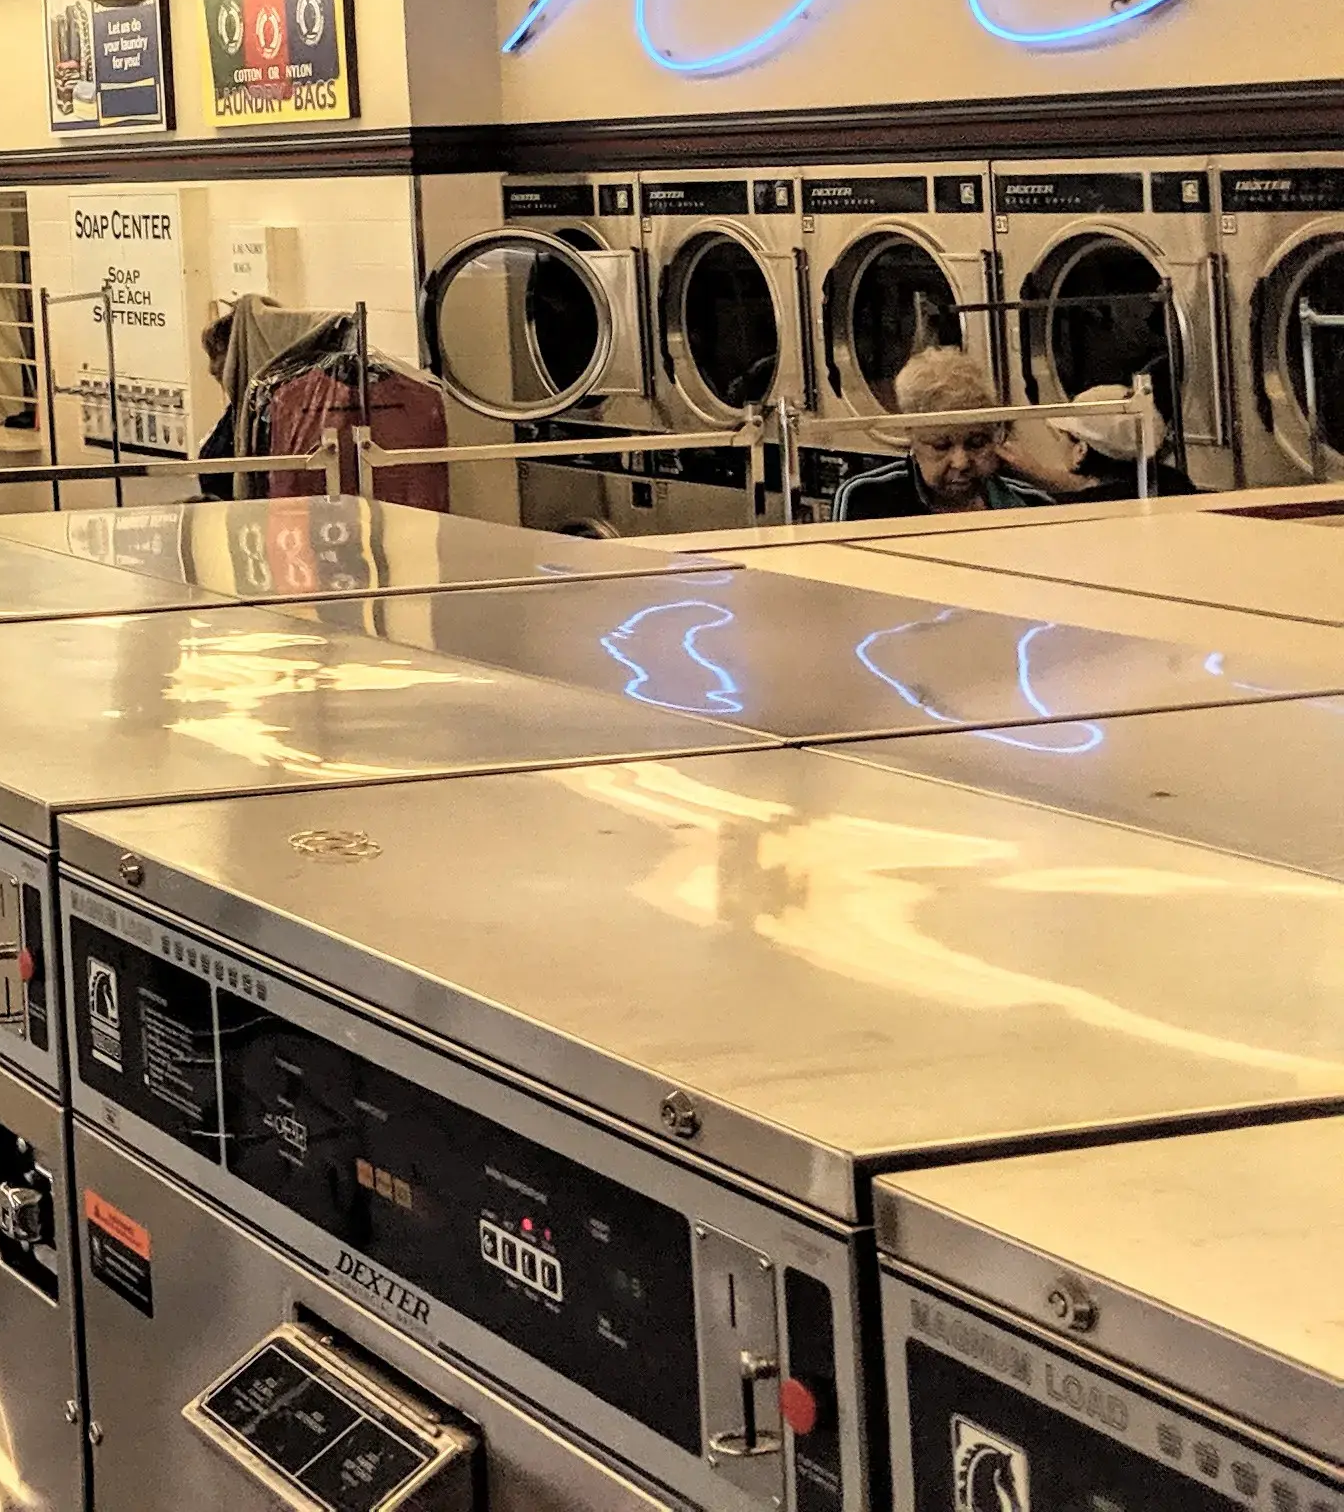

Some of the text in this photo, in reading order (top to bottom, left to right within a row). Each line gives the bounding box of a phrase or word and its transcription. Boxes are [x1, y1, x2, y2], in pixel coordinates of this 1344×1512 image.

[132, 18, 142, 32] do
[104, 35, 148, 56] your laundry
[112, 56, 123, 69] for
[233, 62, 313, 83] COTTON OR NYLON
[215, 78, 337, 116] LAUNDRY BAGS
[812, 187, 852, 197] DEXTER
[1006, 184, 1054, 194] DEXTER
[75, 209, 172, 240] SOAP CENTER
[108, 266, 140, 284] SOAP
[111, 289, 152, 306] LEACH
[335, 1250, 431, 1325] DEXTER
[1045, 1363, 1129, 1432] LOAD
